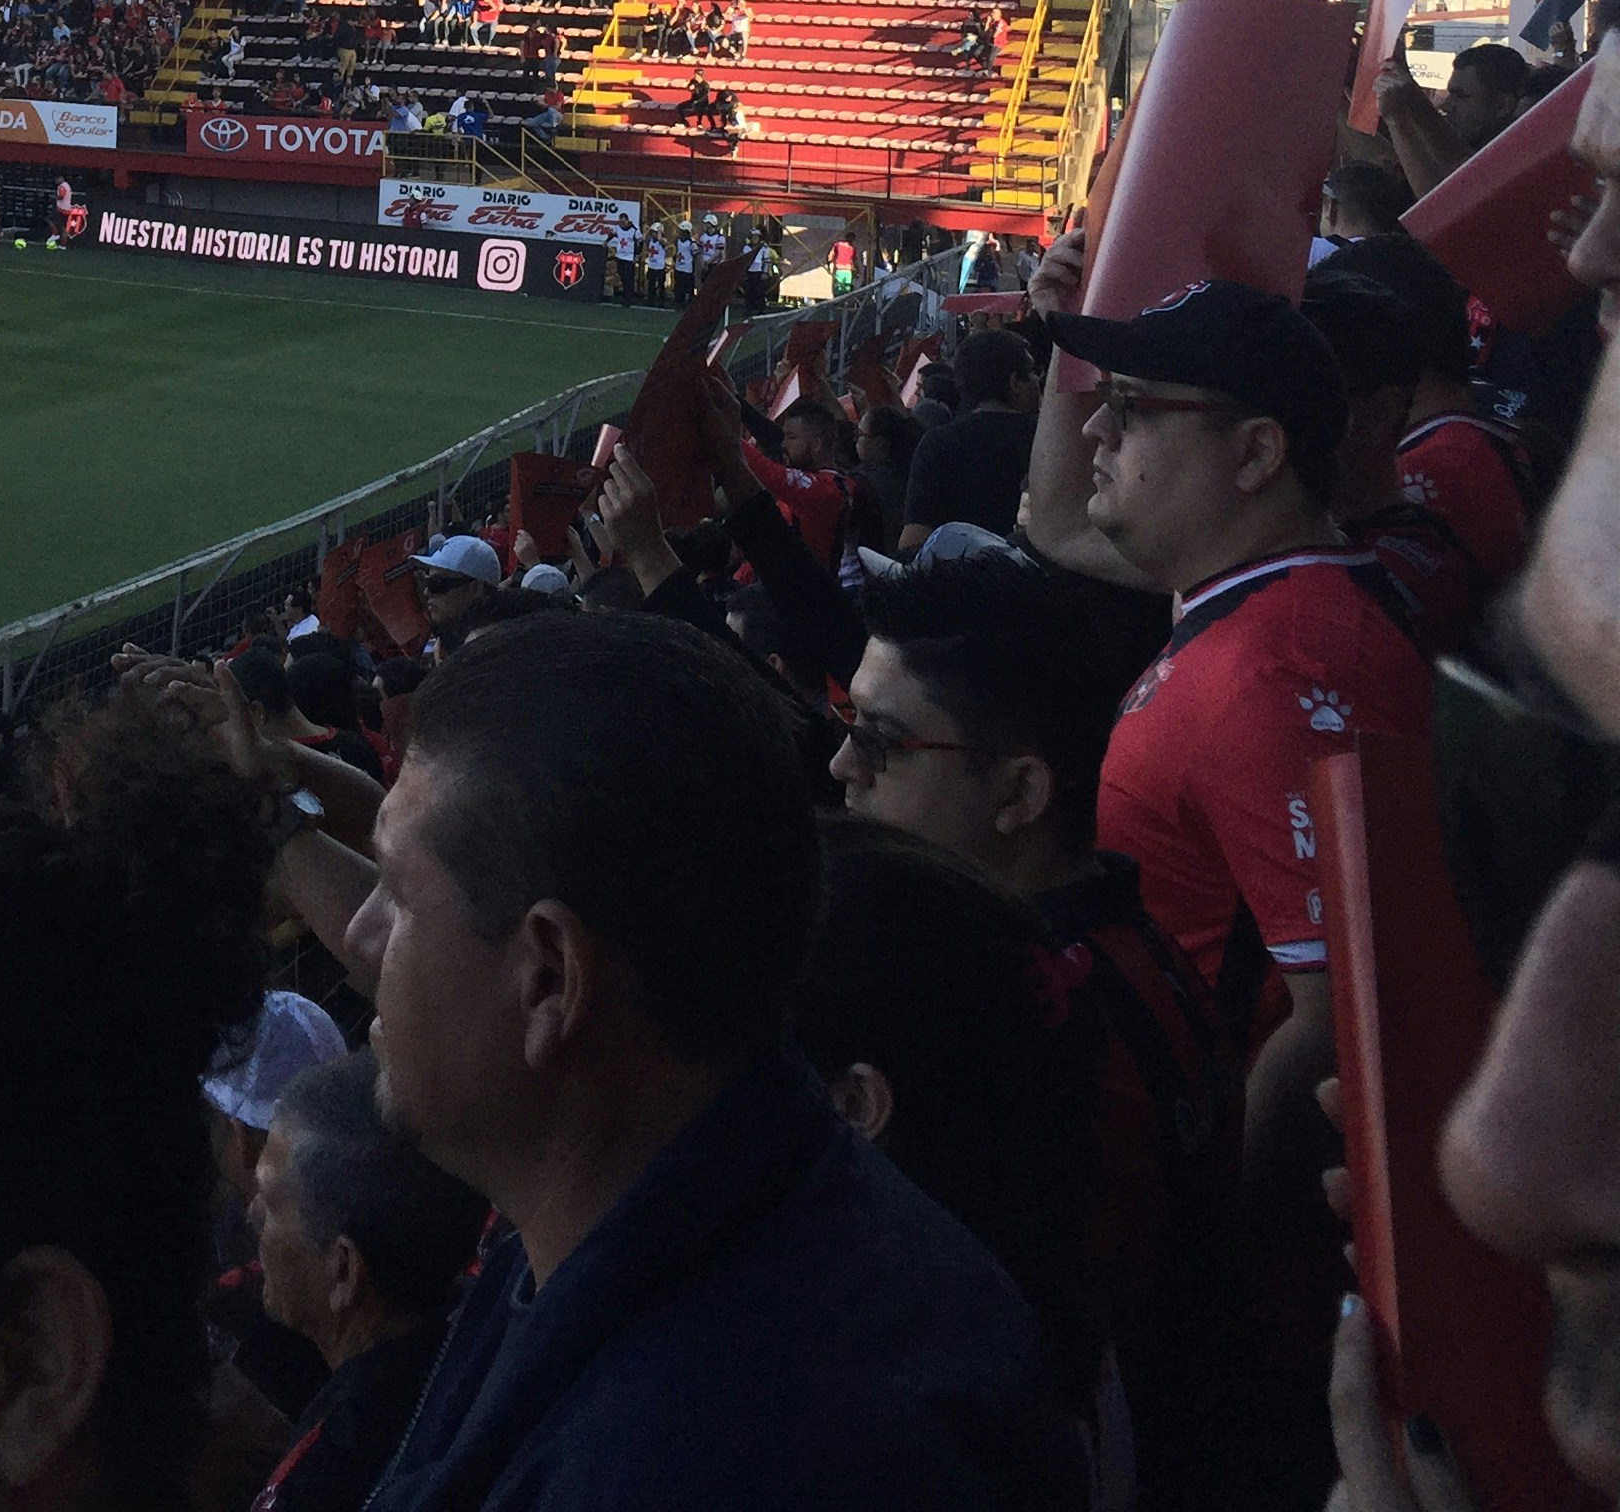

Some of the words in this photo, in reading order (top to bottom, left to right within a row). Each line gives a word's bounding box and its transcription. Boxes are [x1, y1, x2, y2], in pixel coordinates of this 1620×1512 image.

[256, 125, 386, 157] TOYOTA
[482, 190, 531, 207] DIARIO
[568, 199, 618, 215] DIARIO
[467, 205, 545, 230] Extra
[99, 211, 187, 252] NUESTRA
[296, 237, 322, 266] ES
[328, 239, 353, 269] TU
[359, 245, 459, 279] HISTORIA
